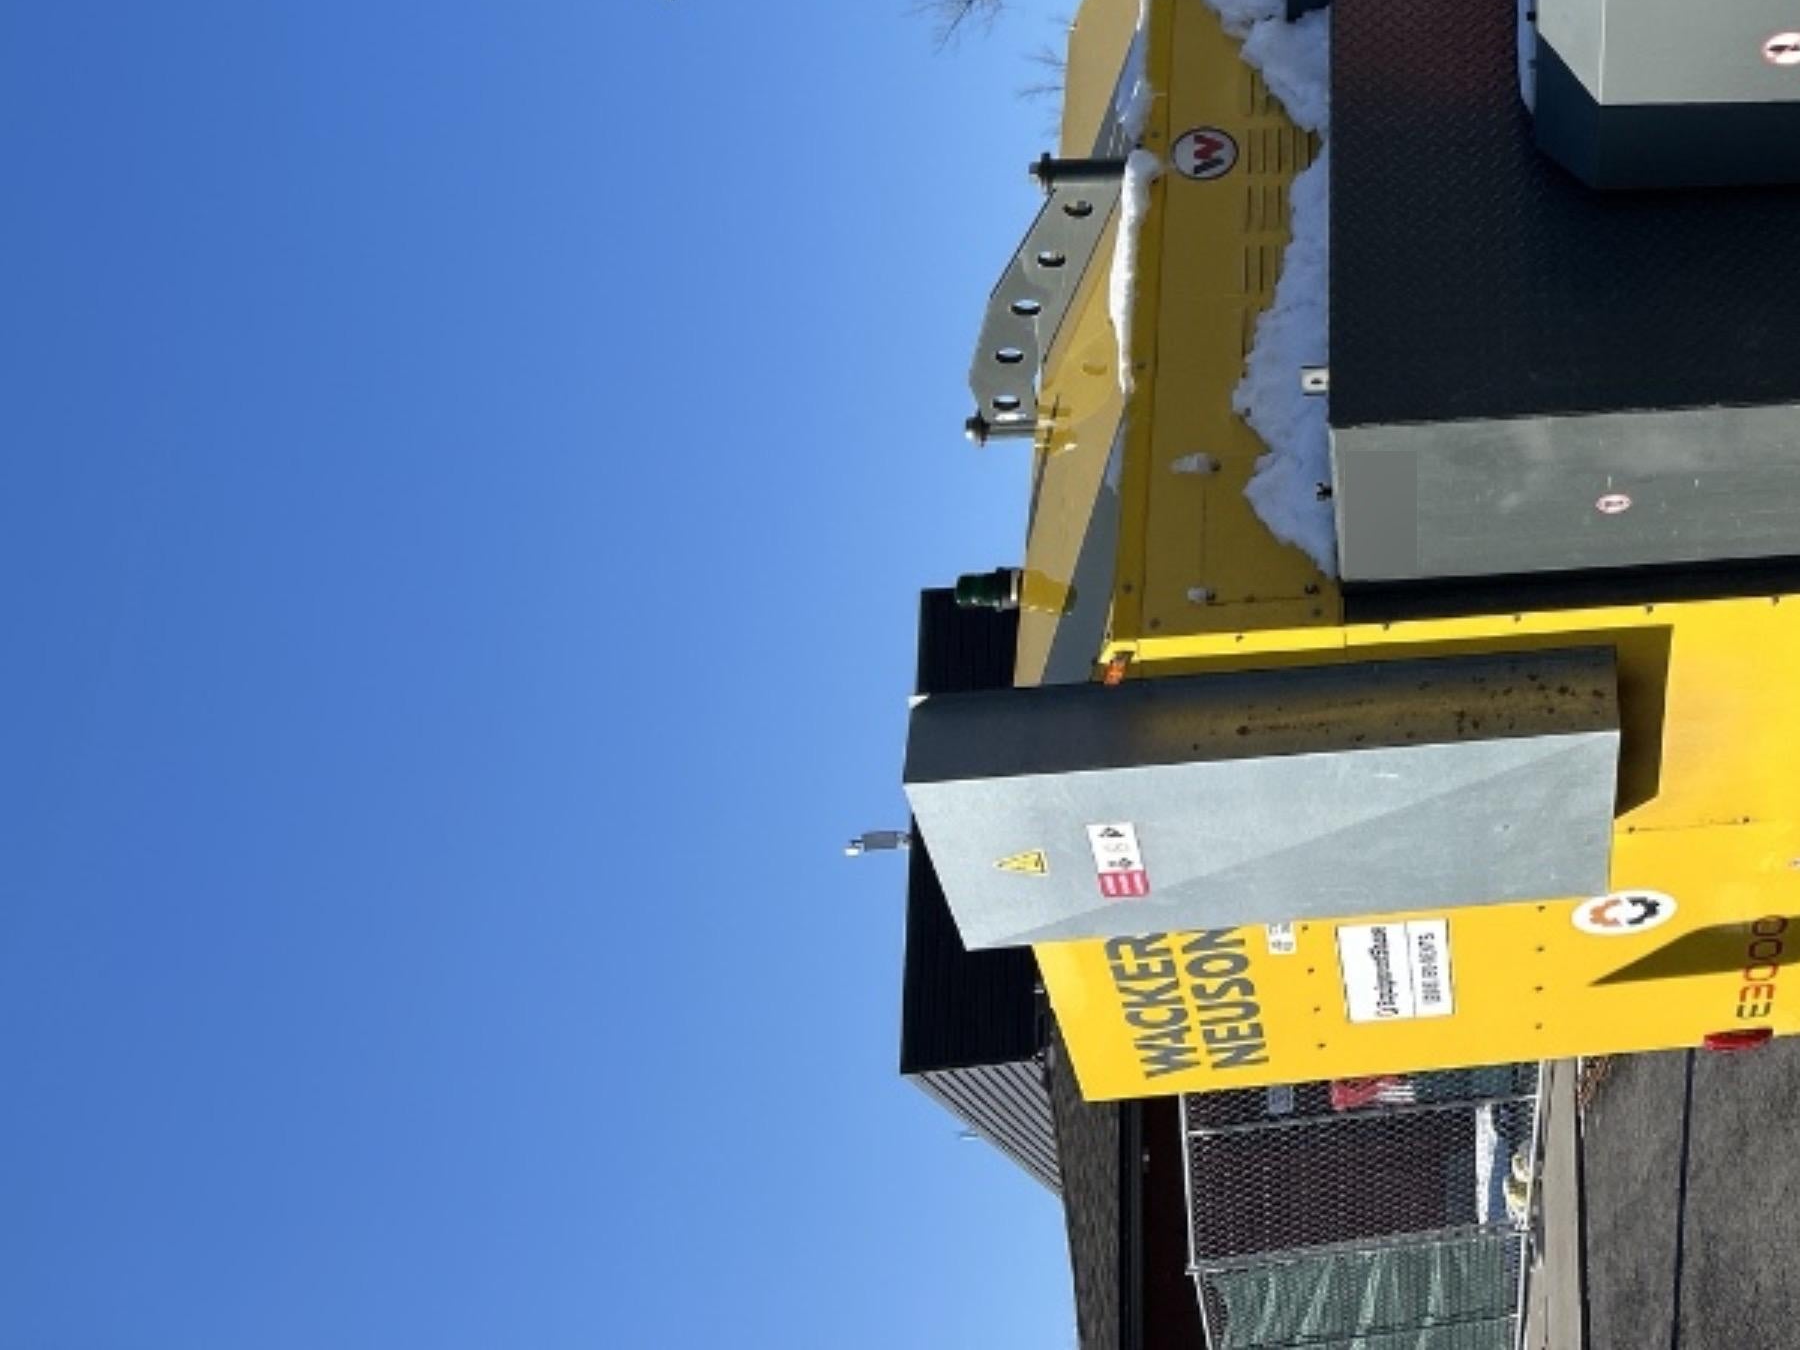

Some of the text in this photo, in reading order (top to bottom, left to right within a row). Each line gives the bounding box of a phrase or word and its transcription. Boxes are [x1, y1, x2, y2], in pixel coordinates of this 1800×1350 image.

[1103, 932, 1201, 1081] WACKER
[1177, 927, 1270, 1070] NEUSON
[1736, 915, 1788, 1019] E3000
